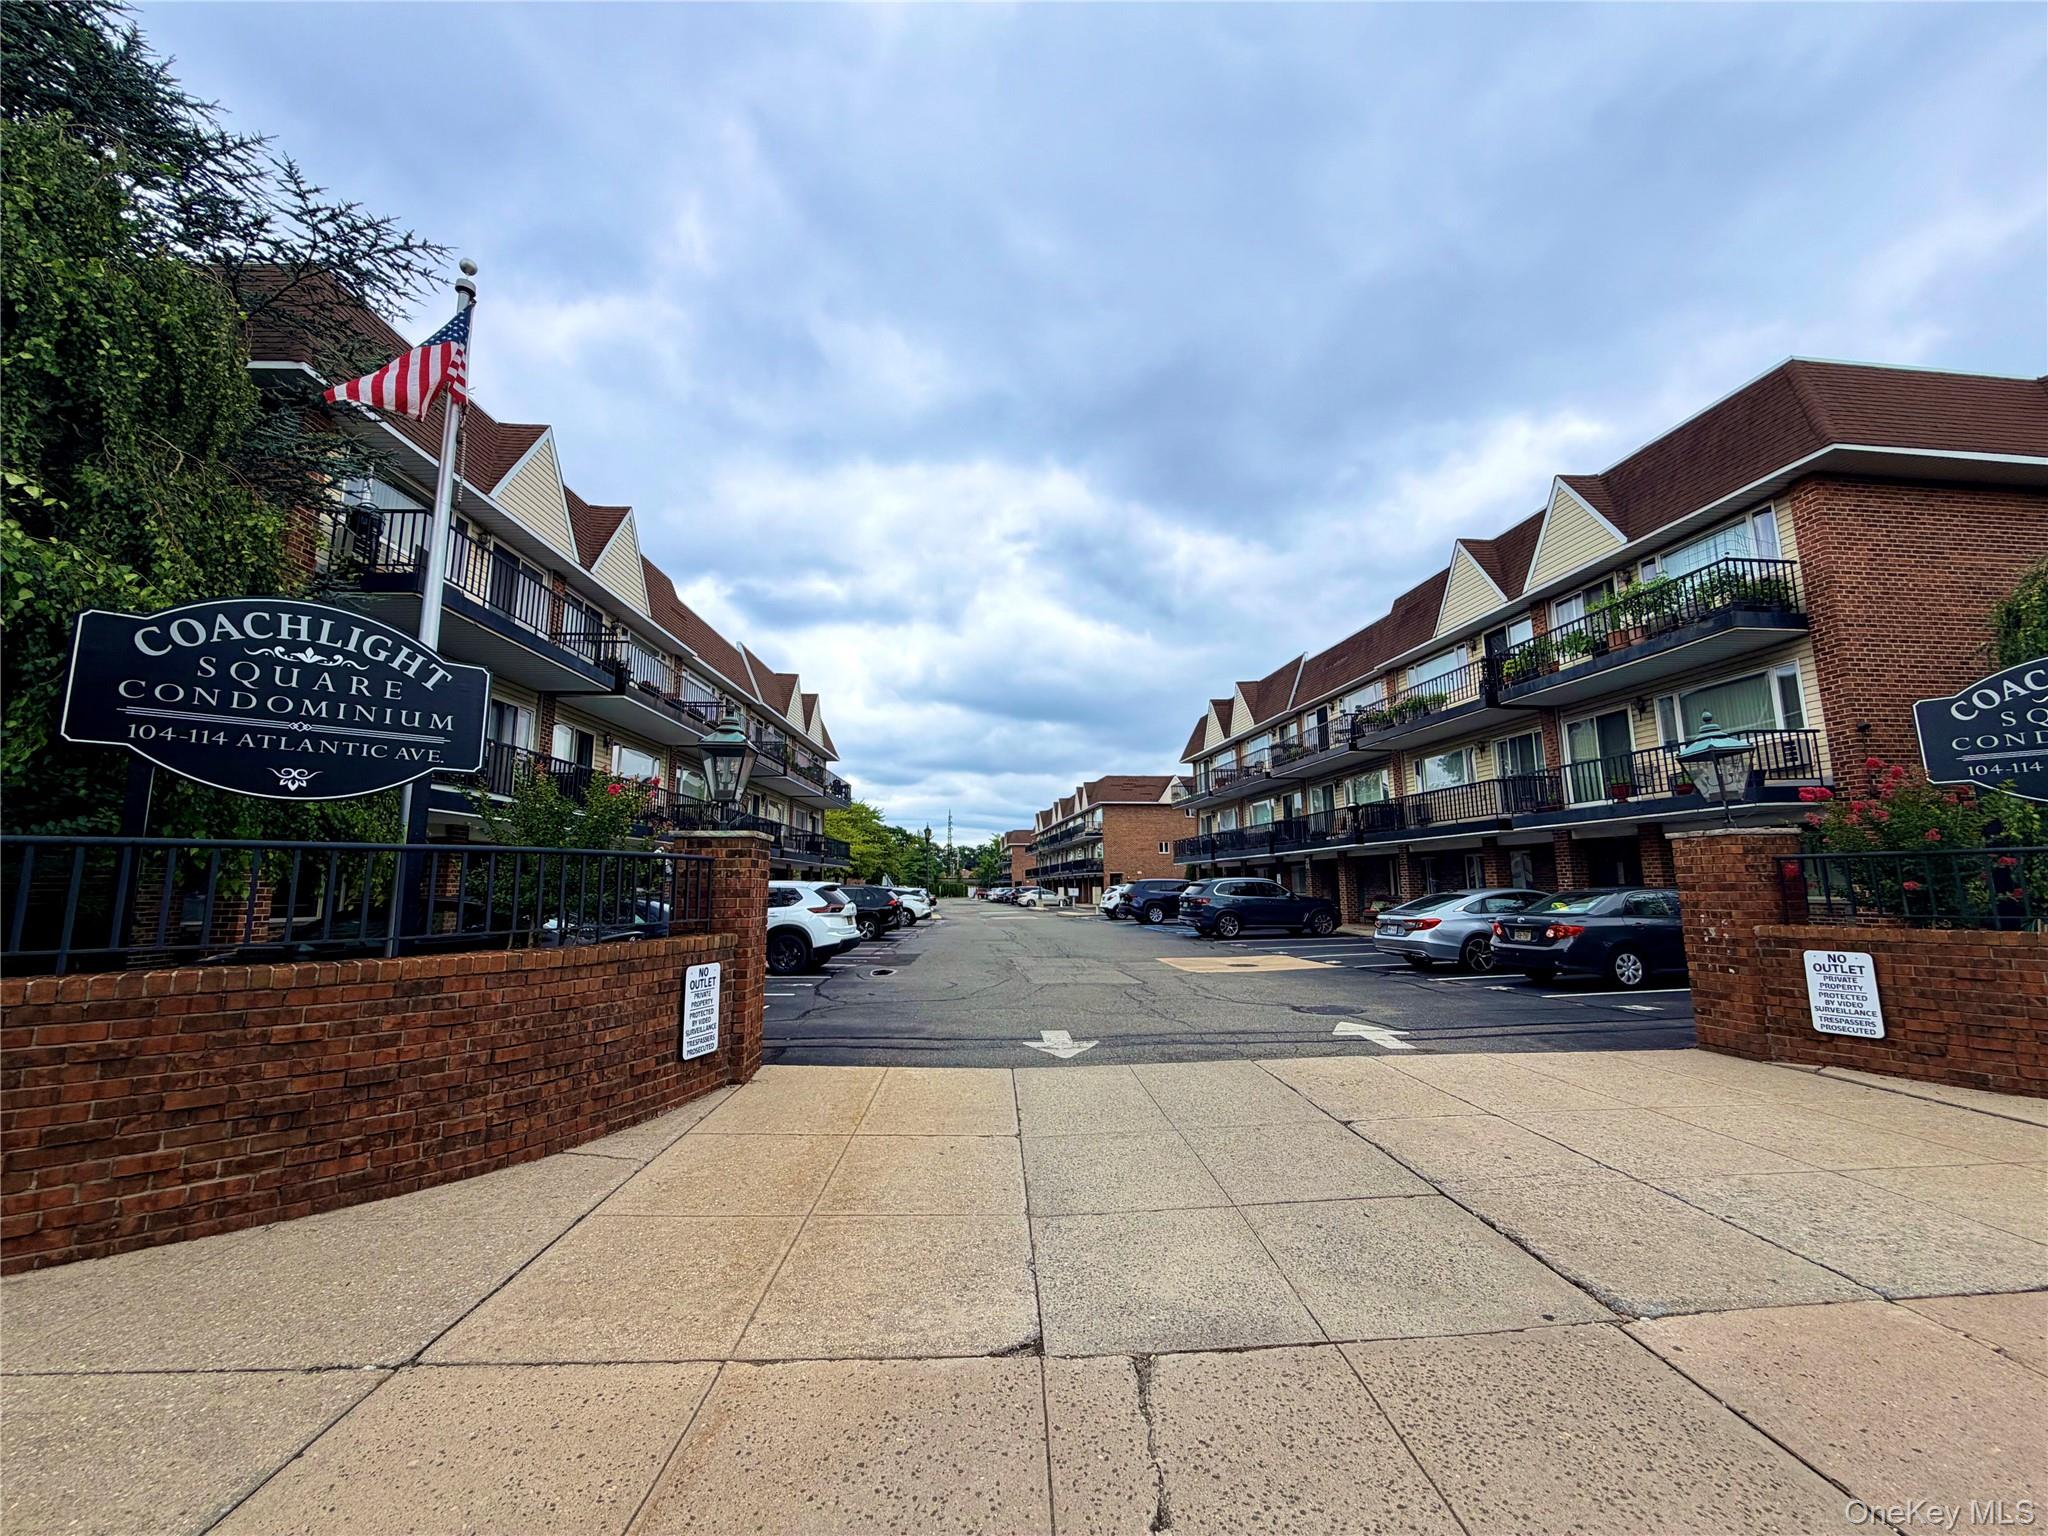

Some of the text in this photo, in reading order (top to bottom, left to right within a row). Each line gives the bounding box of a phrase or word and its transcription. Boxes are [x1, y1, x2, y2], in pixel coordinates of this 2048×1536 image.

[133, 611, 454, 692] COACHLIGHT
[197, 656, 404, 701] SQUARE
[118, 679, 455, 732] CONDOMINIUM
[127, 723, 446, 764] 104-114 ATLANTIC AVE.
[1967, 761, 2044, 776] 104-114
[1827, 953, 1847, 963] NO
[698, 967, 709, 977] NO
[1812, 963, 1865, 975] OUTLET
[689, 976, 717, 990] OUTLET
[1823, 975, 1858, 984] PRIVATE
[1819, 982, 1863, 991] PROPERTY
[693, 990, 712, 1000] PRIVATE
[1818, 991, 1868, 1002] PROTECTED
[690, 998, 713, 1008] PROPERTY
[1837, 1000, 1864, 1009] VIDEO
[689, 1007, 715, 1020] PROTECTED
[1814, 1006, 1878, 1017] SURVEILLANCE
[698, 1016, 712, 1026] VIDEO
[1818, 1015, 1877, 1028] TRESPASSERS
[685, 1022, 717, 1037] SURVEILLANCE
[1820, 1023, 1877, 1036] PROSECUTED
[686, 1034, 716, 1048] TRESPASSERS
[686, 1042, 715, 1056] PROSECUTED
